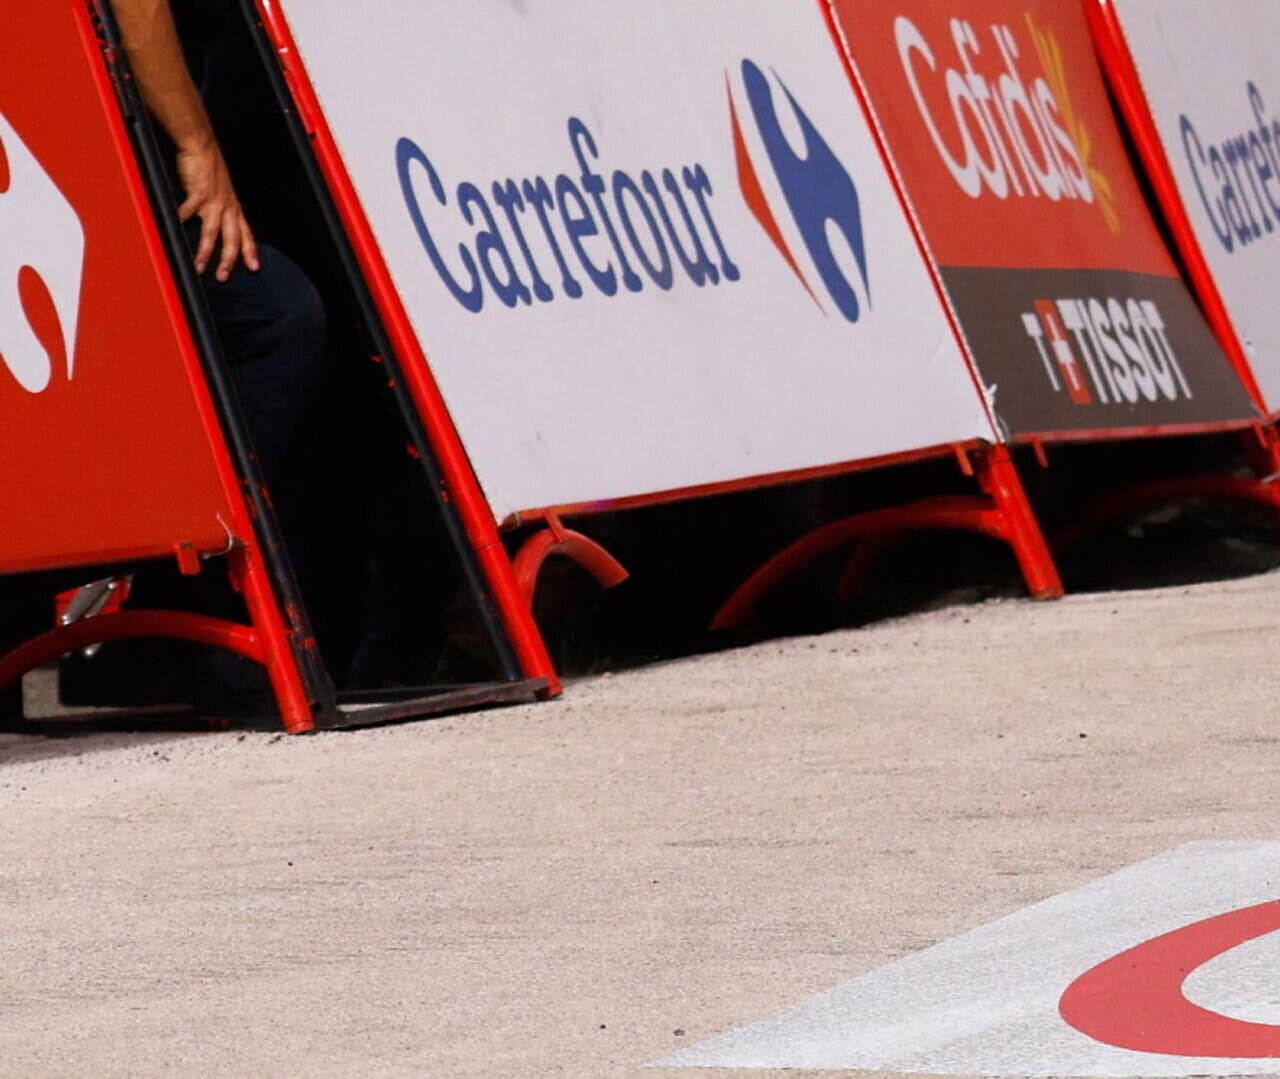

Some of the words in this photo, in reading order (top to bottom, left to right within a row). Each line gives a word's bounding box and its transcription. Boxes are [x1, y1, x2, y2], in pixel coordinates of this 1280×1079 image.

[894, 15, 1094, 205] Cofidis
[395, 116, 741, 314] Carrefour
[1056, 297, 1195, 405] TISSOT
